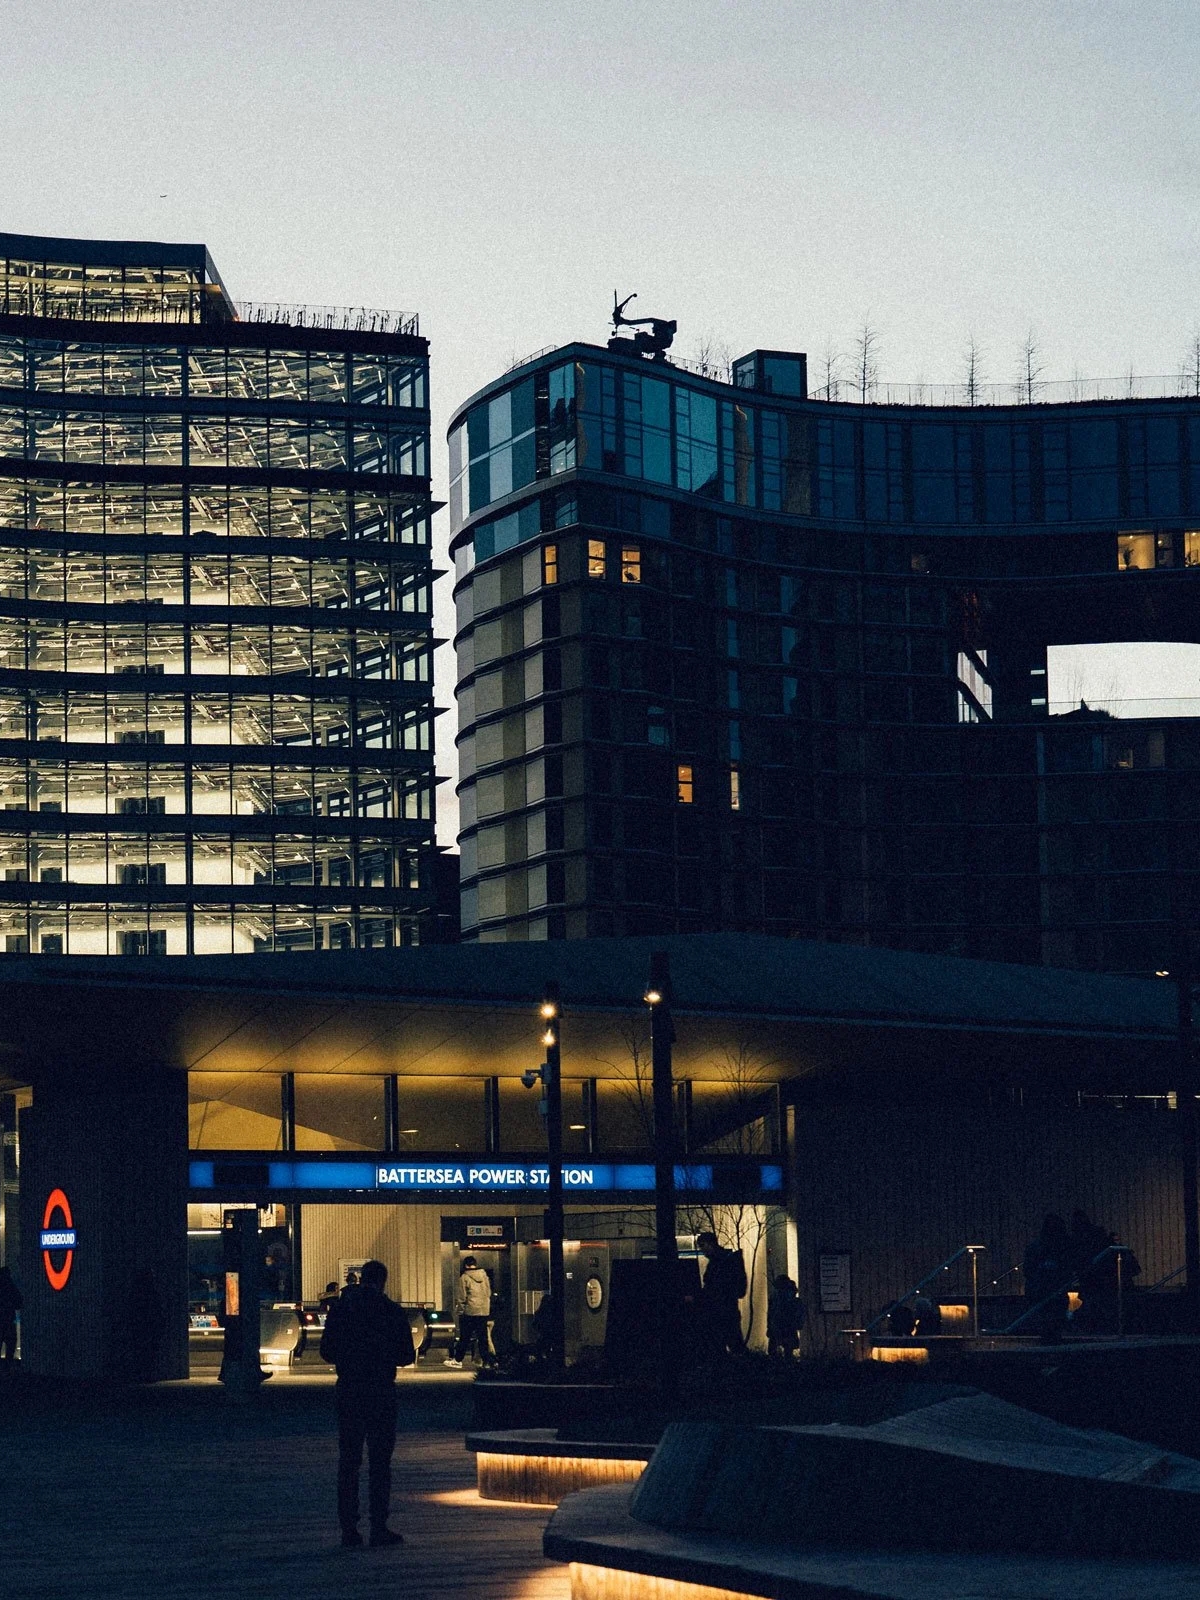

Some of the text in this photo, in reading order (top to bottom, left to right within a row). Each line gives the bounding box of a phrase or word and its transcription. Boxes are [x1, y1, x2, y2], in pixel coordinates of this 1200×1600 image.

[379, 1168, 593, 1184] BATTERSEA POWER STION
[41, 1233, 75, 1245] UNDERGROUND
